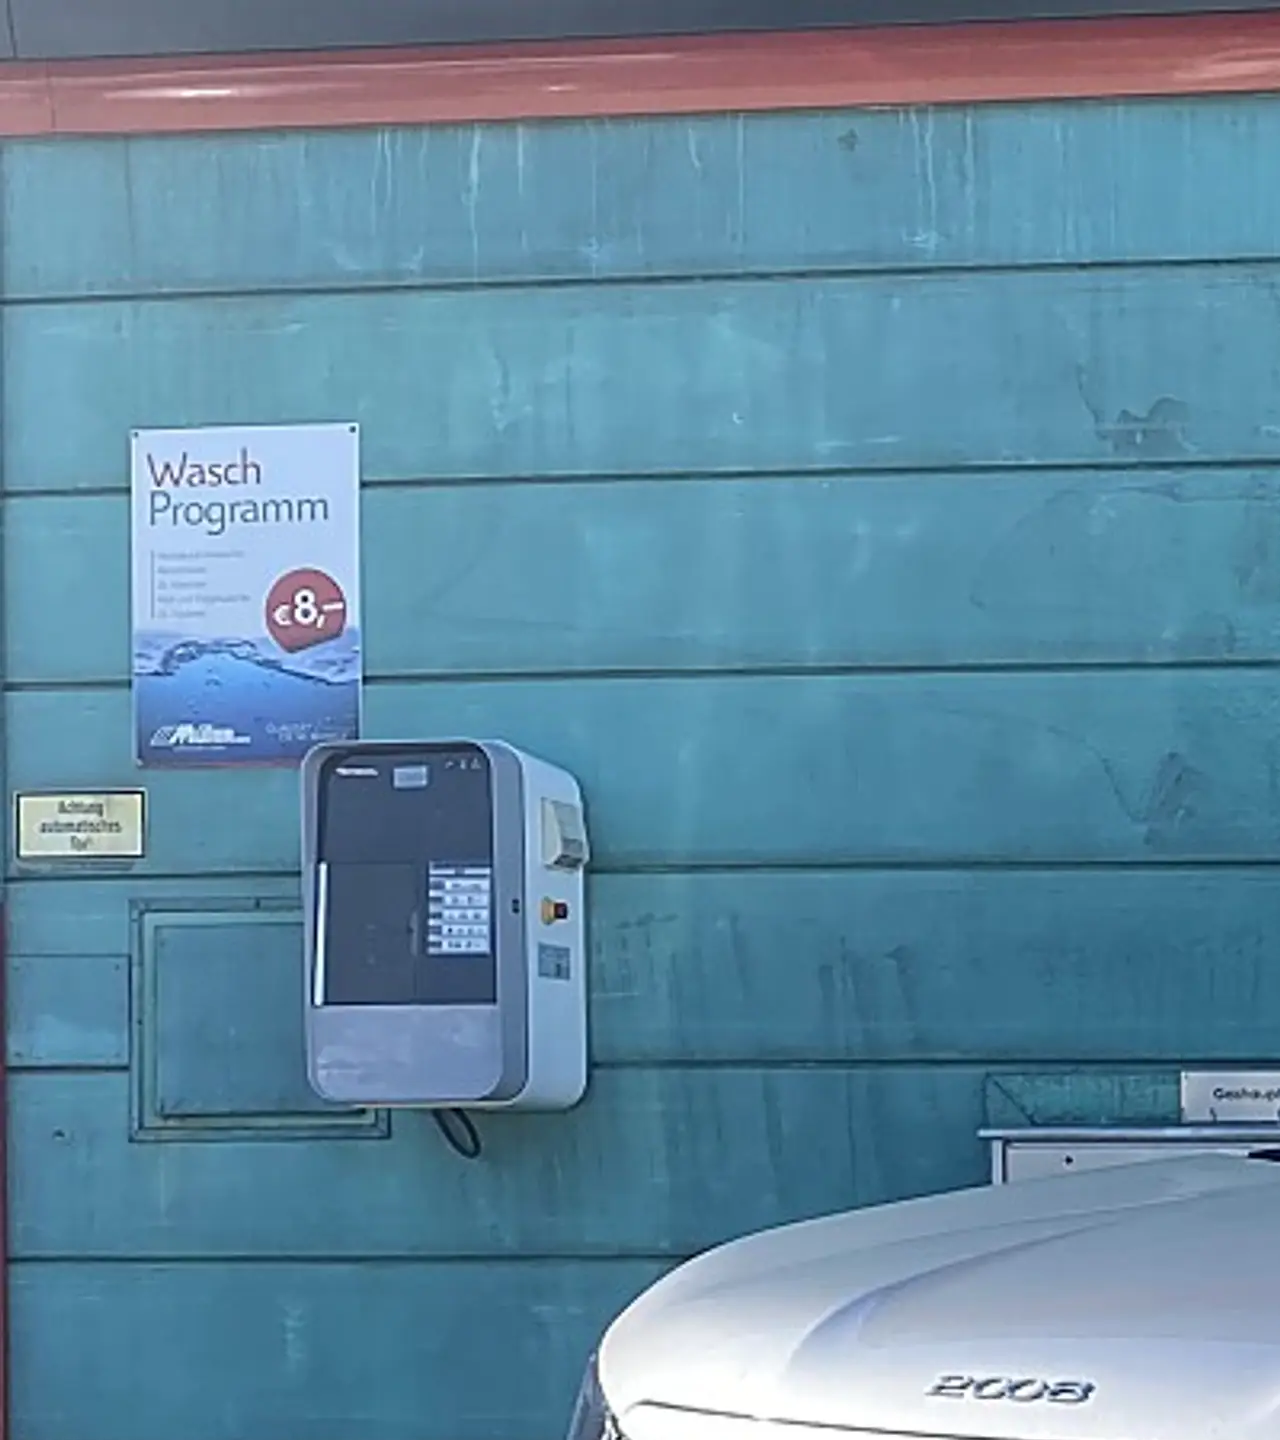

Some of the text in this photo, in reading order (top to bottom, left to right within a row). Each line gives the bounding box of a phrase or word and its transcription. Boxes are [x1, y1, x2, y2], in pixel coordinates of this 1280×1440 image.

[147, 448, 262, 488] Wasch
[150, 491, 330, 536] Programm
[57, 800, 104, 817] Achtung
[923, 1375, 1097, 1404] 2008
